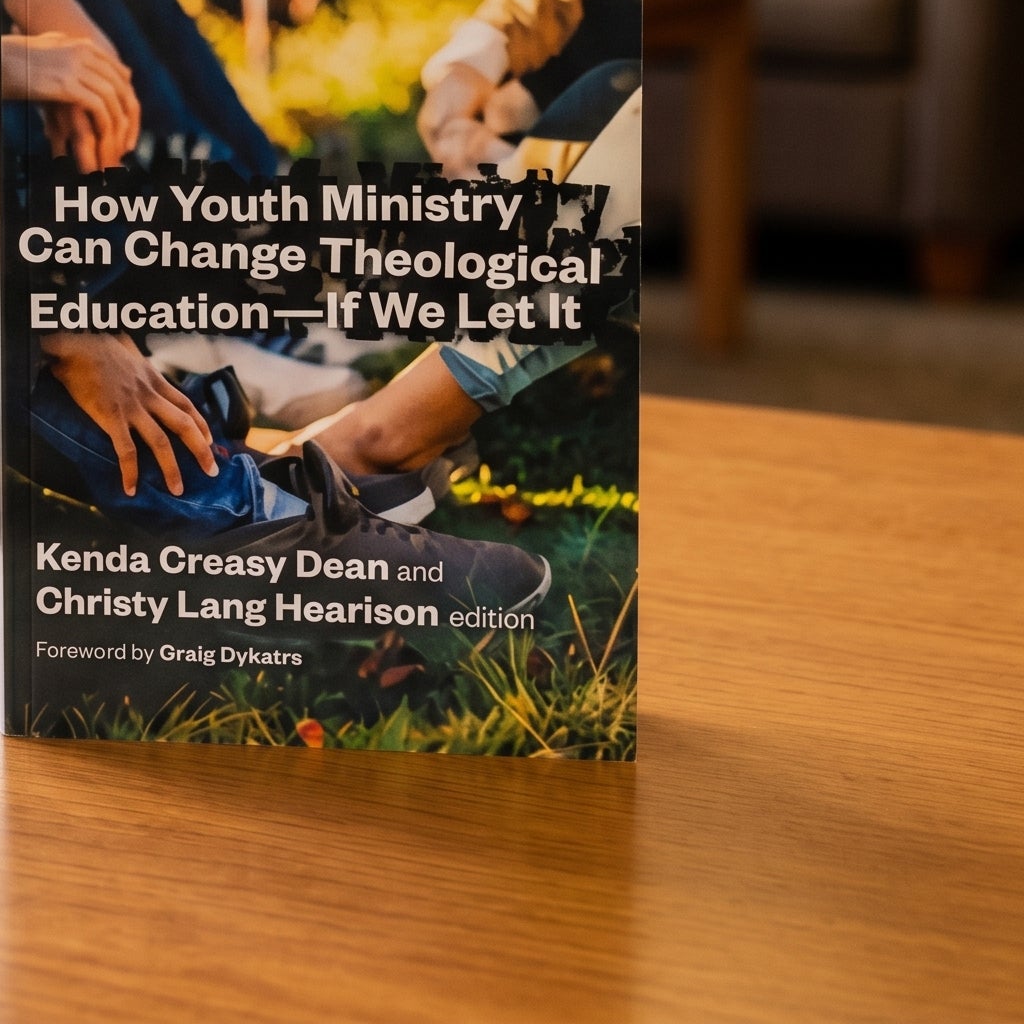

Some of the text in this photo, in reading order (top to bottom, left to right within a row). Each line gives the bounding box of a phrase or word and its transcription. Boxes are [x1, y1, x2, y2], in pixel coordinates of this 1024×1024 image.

[56, 184, 523, 231] How Youth Ministry
[18, 227, 601, 289] Can Change Theological
[369, 292, 445, 329] We
[458, 292, 535, 329] Let
[549, 292, 582, 329] It
[36, 542, 444, 584] Kenda Creasy Dean and
[36, 586, 535, 630] Christy Lang Hearison edition
[36, 641, 303, 667] Foreword by Graig Dykatrs
